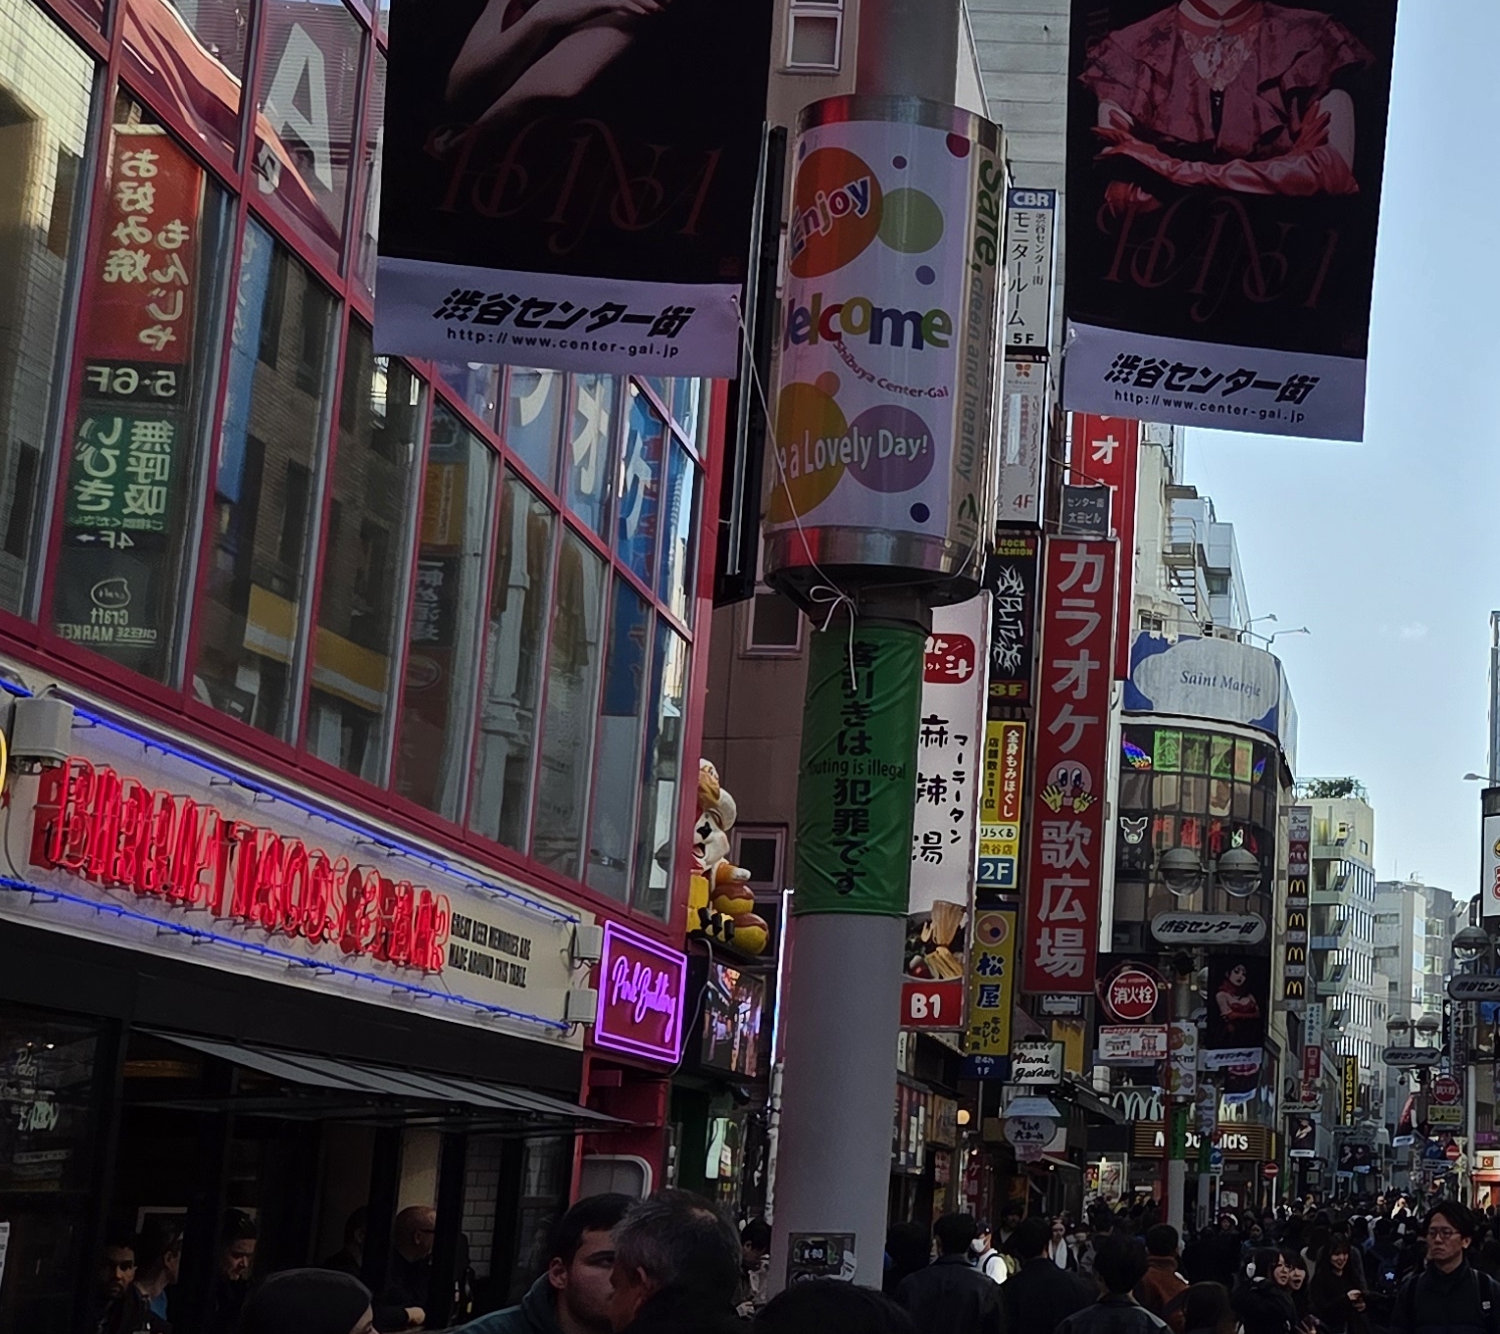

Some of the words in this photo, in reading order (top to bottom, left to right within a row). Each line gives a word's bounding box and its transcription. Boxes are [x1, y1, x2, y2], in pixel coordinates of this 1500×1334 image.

[1012, 191, 1050, 207] CBR
[1008, 211, 1030, 328] モニタールーム
[432, 288, 696, 338] 渋谷センター街
[446, 326, 680, 358] http://www.center-gai.jp
[833, 338, 877, 385] Shibuya
[1012, 332, 1035, 345] 5F
[1103, 351, 1321, 406] 渋谷センター街
[1114, 388, 1306, 424] http://www.center-gai.jp
[803, 425, 873, 471] Lovely
[877, 427, 929, 460] Day!
[1011, 493, 1035, 509] 4F
[1048, 542, 1107, 754] カラオケ
[989, 683, 1024, 698] 3F
[1180, 669, 1217, 688] Saint
[829, 639, 881, 897] 客引きは犯罪です
[949, 734, 969, 845] マーラータン
[1003, 727, 1020, 819] 全身もみほぐし
[982, 862, 1011, 881] 2F
[1033, 818, 1093, 979] 歌広場
[611, 955, 642, 1007] Pink
[975, 952, 1004, 1010] 松屋
[1112, 985, 1155, 1005] 消火栓
[910, 992, 942, 1019] B1
